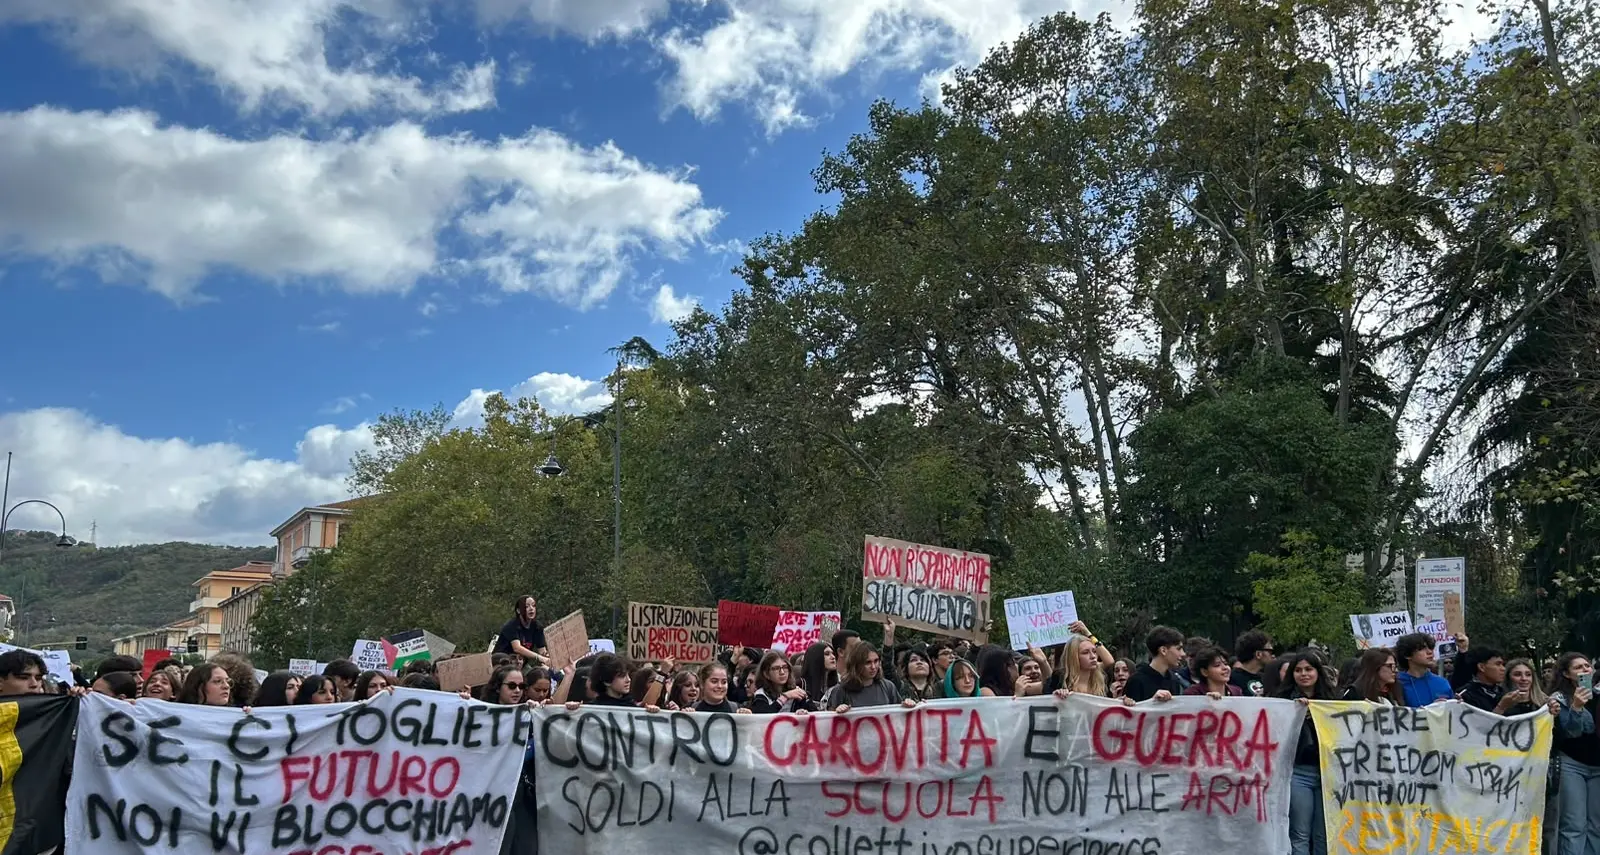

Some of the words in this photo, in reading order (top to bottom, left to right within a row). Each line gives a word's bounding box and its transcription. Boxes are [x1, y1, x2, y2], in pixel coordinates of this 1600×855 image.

[864, 542, 902, 577] NON
[904, 545, 991, 594] RISPARMIATE
[863, 581, 903, 616] SUGLI
[1028, 610, 1065, 628] VINCE
[1055, 594, 1071, 610] SI
[631, 627, 646, 644] UN
[648, 627, 689, 643] DIRITTO
[690, 630, 718, 644] NON
[631, 644, 646, 660] UN
[101, 710, 189, 767] SE
[228, 714, 298, 761] CI
[326, 698, 530, 749] TOGLIETE
[540, 711, 738, 771] CONTRO
[763, 708, 997, 775] CAROVITA
[1023, 705, 1060, 761] E
[1092, 706, 1279, 777] GUERRA
[1331, 705, 1429, 736] THERE
[1448, 709, 1474, 739] IS
[1486, 717, 1535, 752] NO
[209, 759, 260, 806] IL
[280, 750, 460, 804] FUTURO
[1333, 740, 1457, 783] FREEDOM
[561, 775, 675, 836] SOLDI
[697, 772, 791, 823] ALLA
[821, 774, 1004, 824] SCUOLA
[1022, 766, 1089, 817] NON
[1104, 767, 1170, 815] ALLE
[1181, 771, 1269, 823] ARMI
[1332, 779, 1438, 811] WITHOUT
[86, 793, 182, 848] NOI
[210, 810, 251, 854] VI
[271, 792, 508, 849] BLOCCHIAMO
